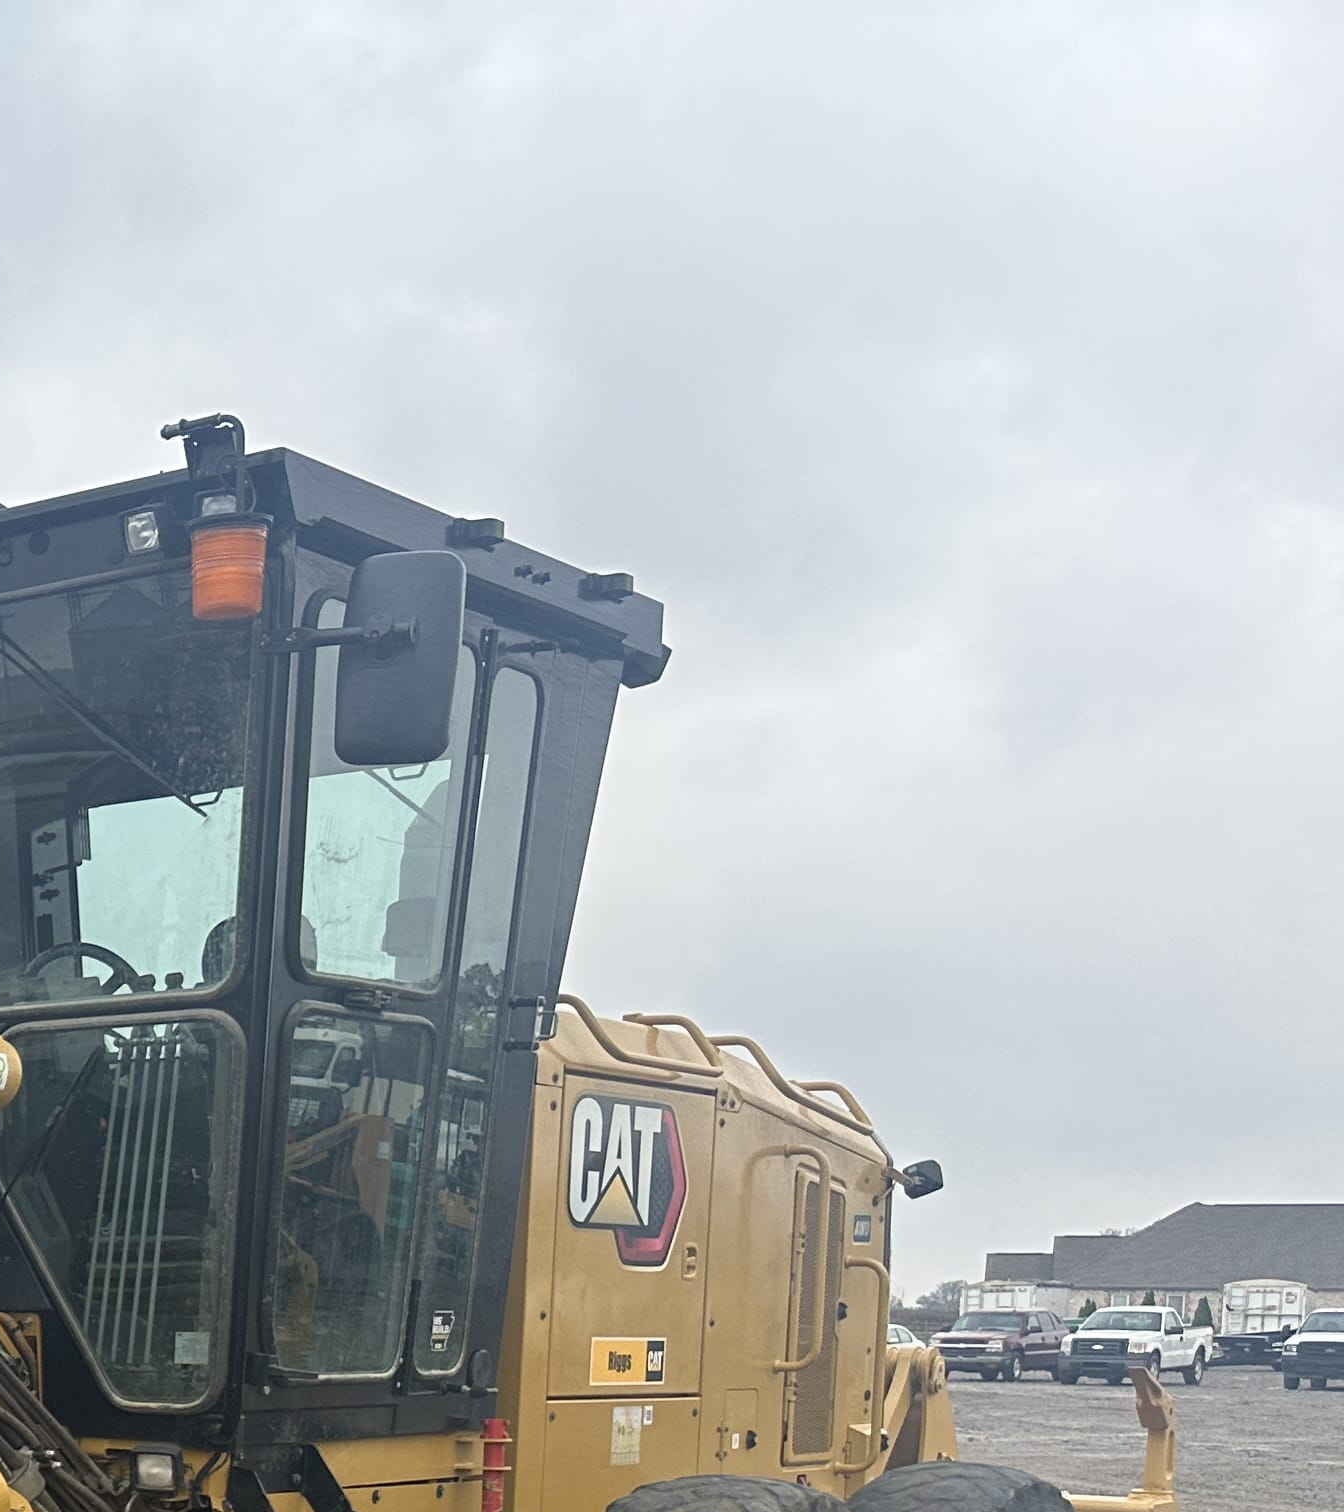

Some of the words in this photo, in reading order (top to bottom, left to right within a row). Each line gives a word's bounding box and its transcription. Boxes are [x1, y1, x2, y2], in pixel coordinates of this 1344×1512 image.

[568, 1096, 664, 1227] CAT
[608, 1349, 633, 1374] Riggs
[647, 1348, 664, 1371] CAT
